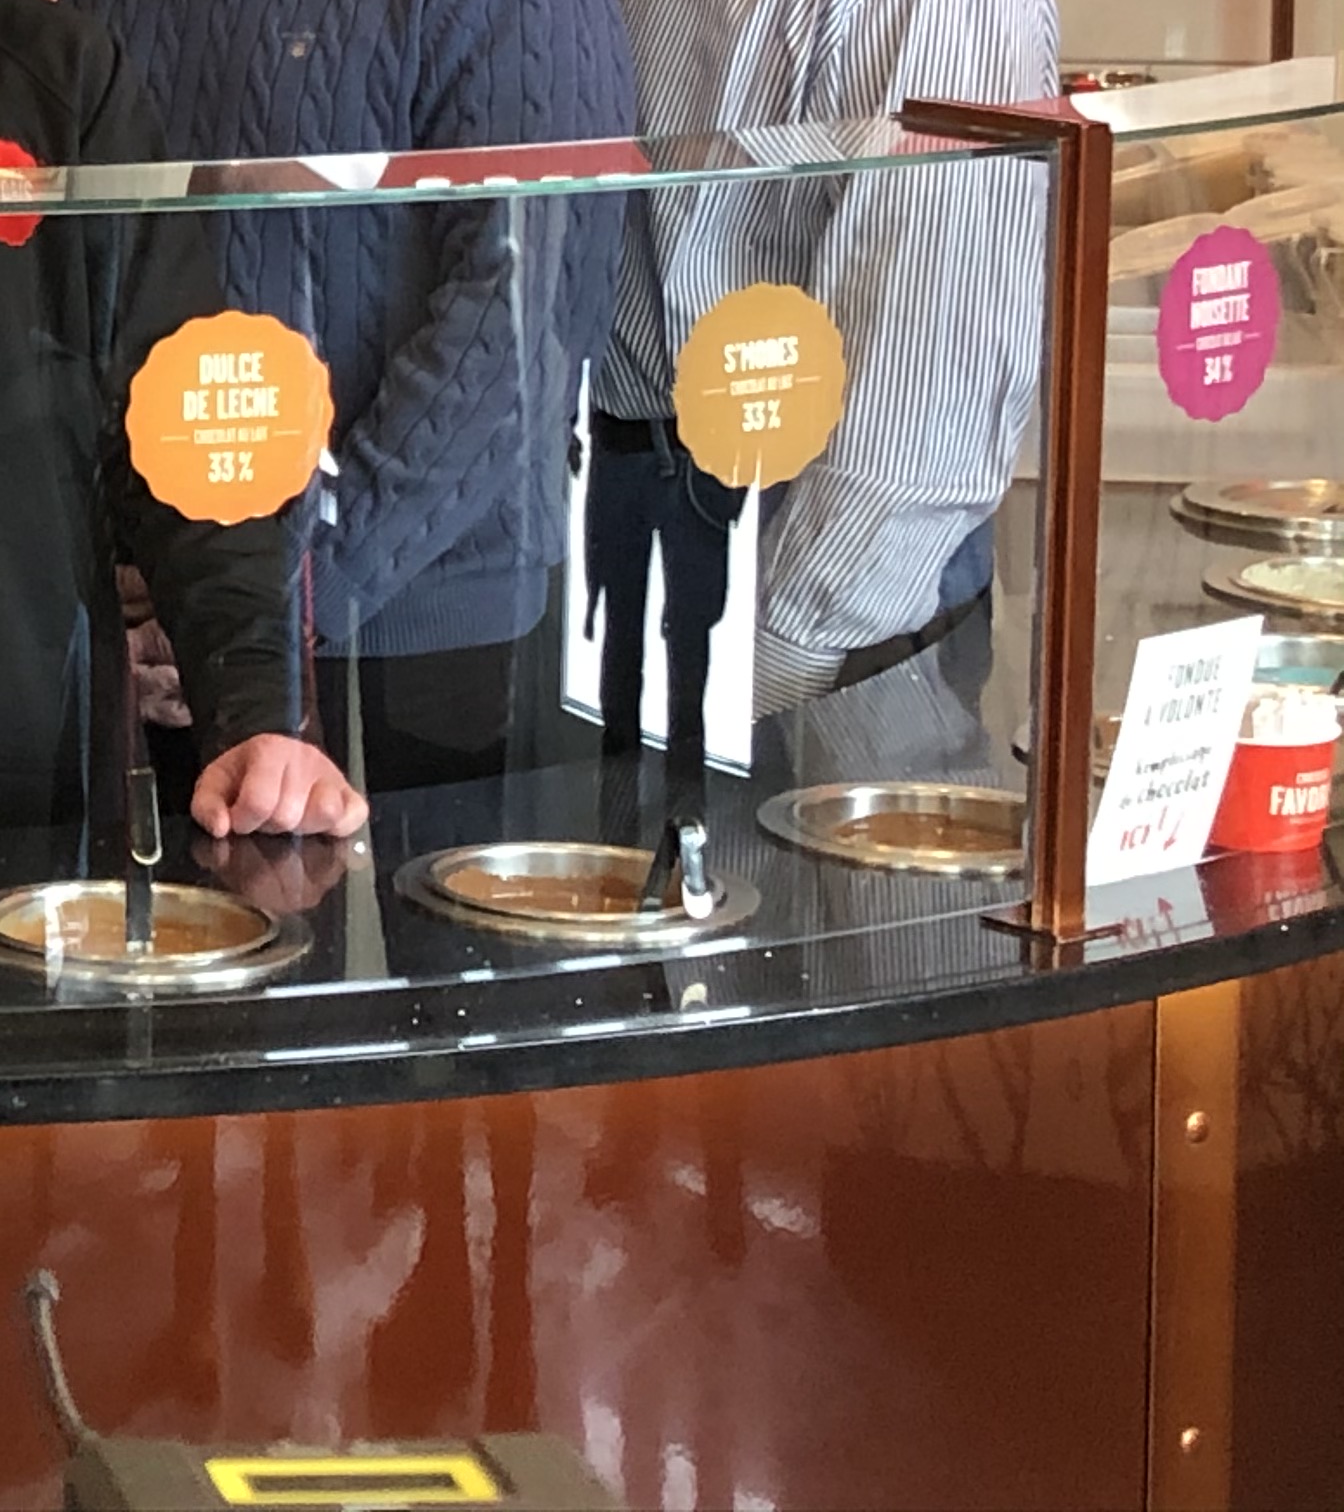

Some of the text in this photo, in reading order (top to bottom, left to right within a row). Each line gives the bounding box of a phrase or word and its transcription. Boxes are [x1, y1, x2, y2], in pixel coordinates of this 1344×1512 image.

[1190, 293, 1251, 330] NOISETTE
[199, 352, 264, 385] DULCE
[183, 386, 280, 421] DE LECHE
